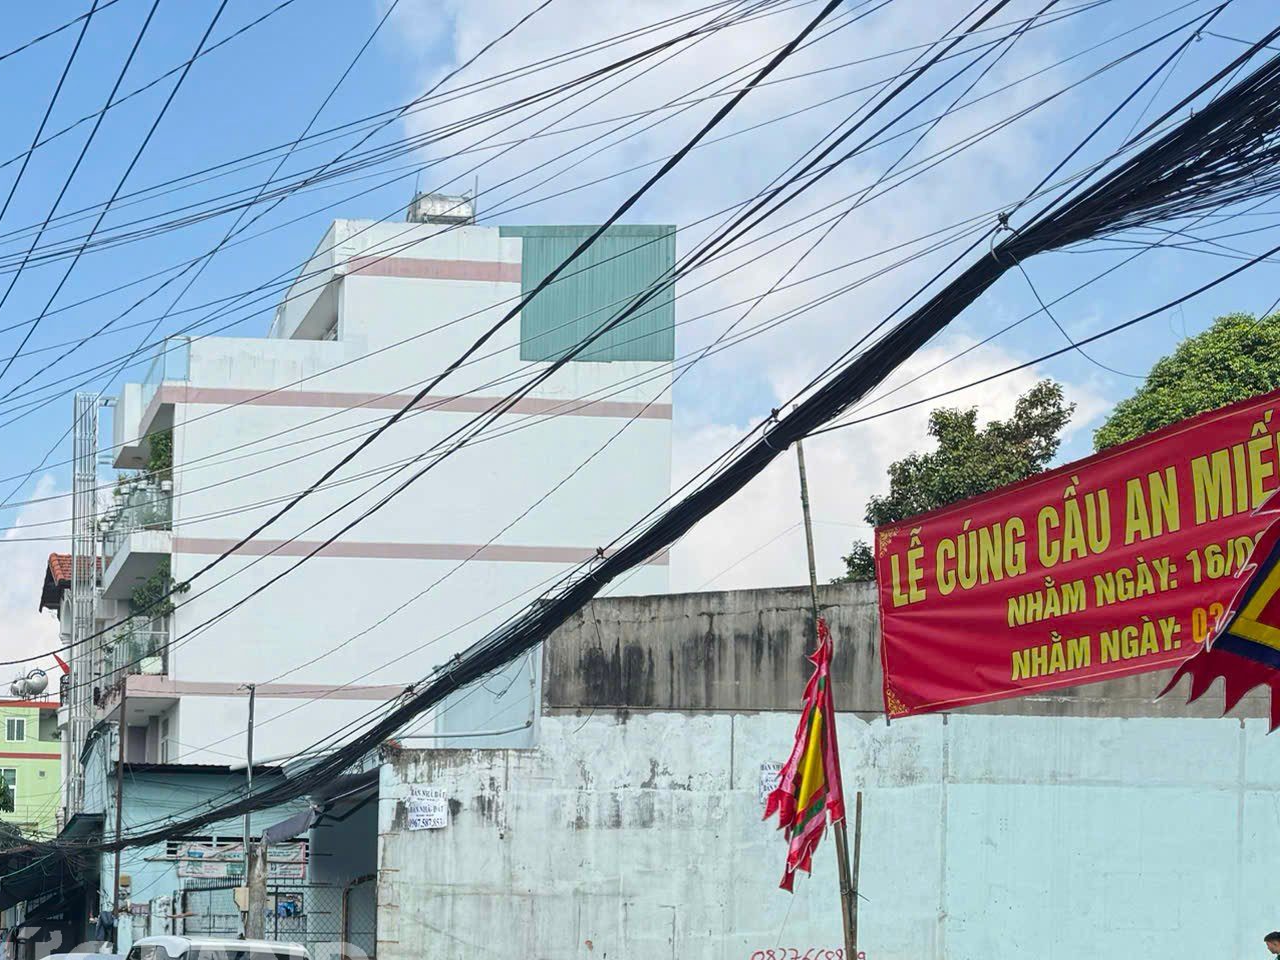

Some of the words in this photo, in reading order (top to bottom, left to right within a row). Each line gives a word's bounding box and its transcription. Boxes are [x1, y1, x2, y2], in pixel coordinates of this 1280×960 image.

[890, 526, 928, 608] LỄ
[935, 519, 1026, 597] CÚNG
[1037, 475, 1112, 569] CẦU
[1124, 465, 1181, 545] AN
[1191, 409, 1280, 525] MIẾ
[1007, 576, 1087, 628] NHẰM
[1094, 555, 1178, 618] NGÀY:
[1186, 531, 1265, 583] 16/0
[1011, 631, 1091, 681] NHẰM
[1100, 616, 1182, 666] NGÀY:
